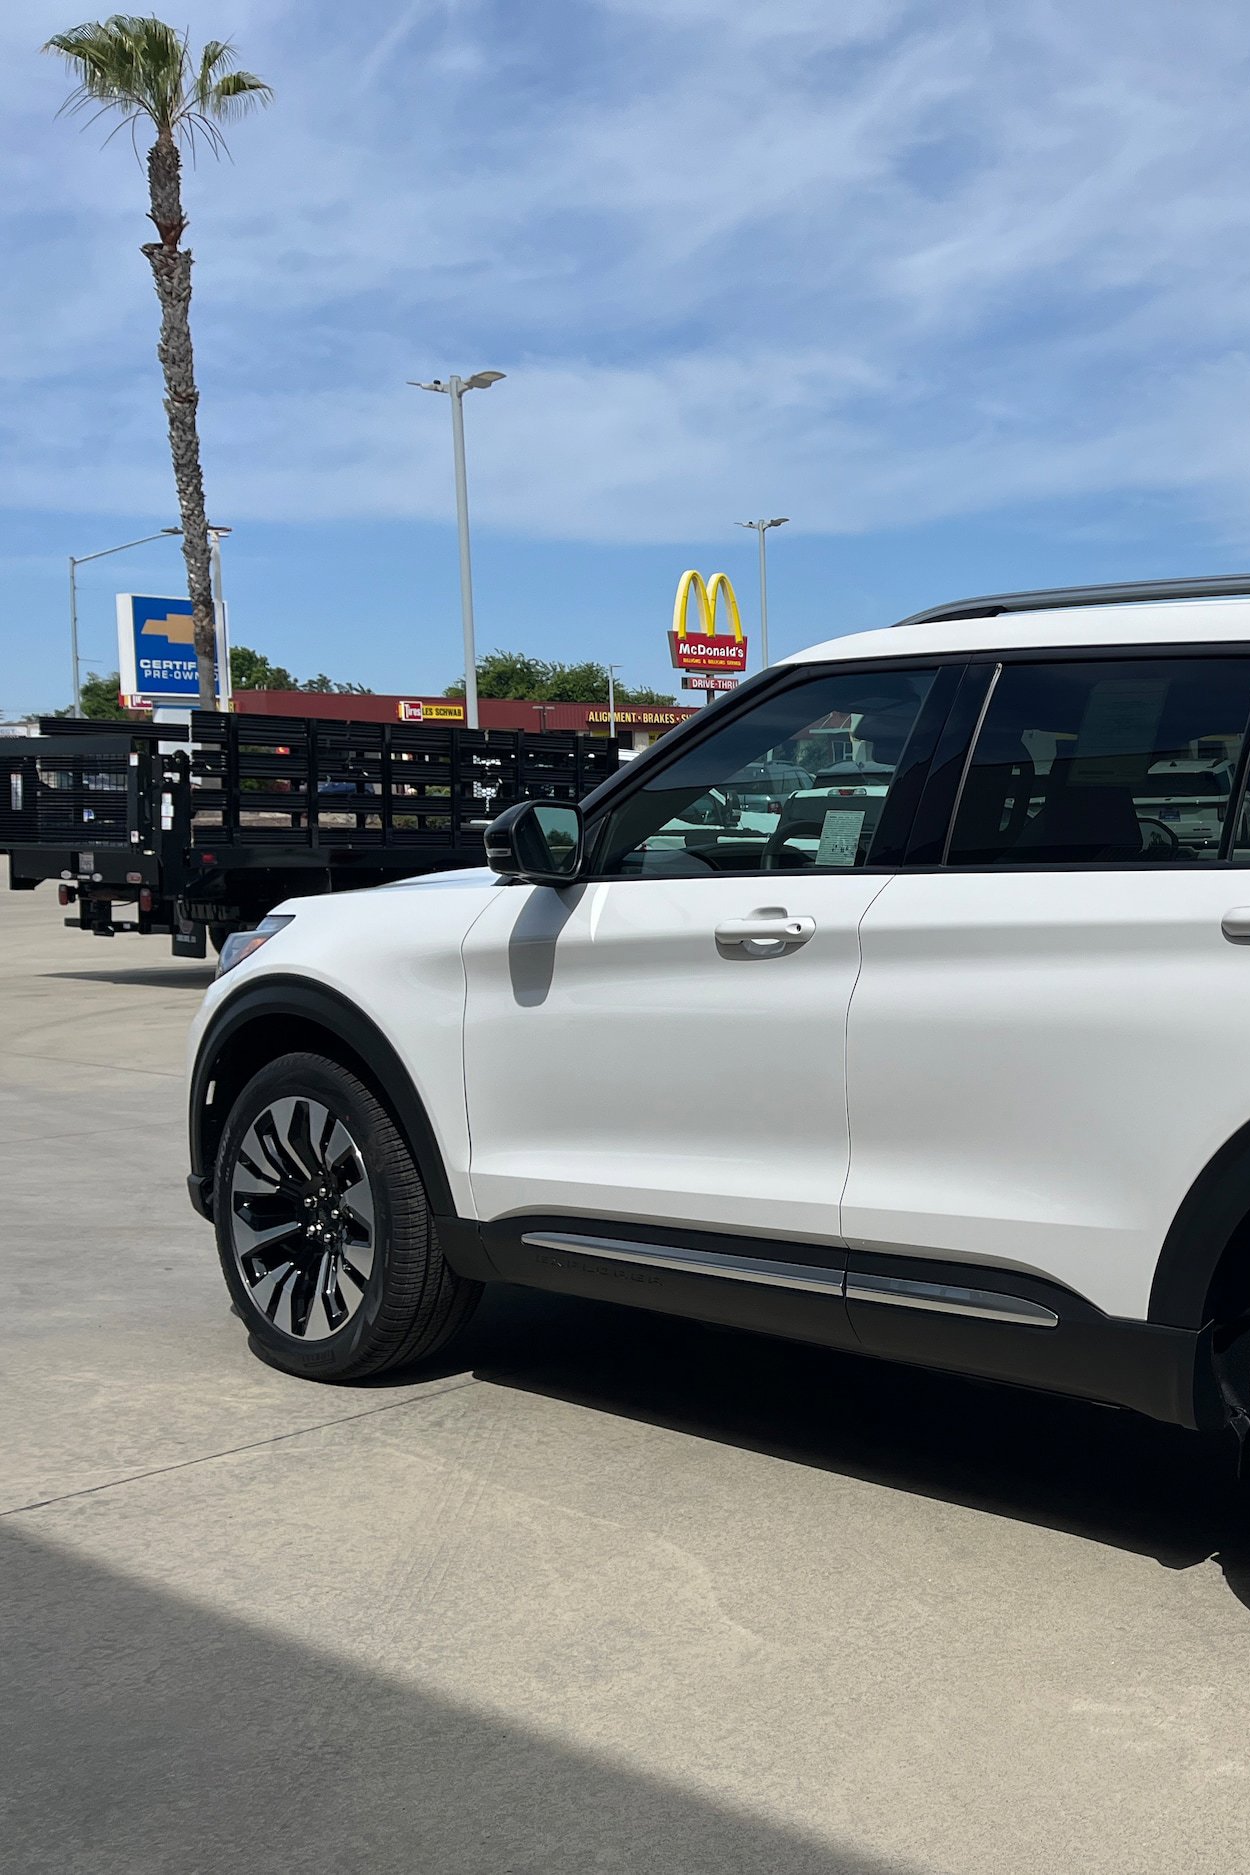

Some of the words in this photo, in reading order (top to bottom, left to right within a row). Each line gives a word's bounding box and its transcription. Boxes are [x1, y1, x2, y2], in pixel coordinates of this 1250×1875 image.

[678, 643, 744, 658] McDonald's
[421, 707, 433, 717] LES
[435, 707, 462, 718] SCHWAB
[642, 713, 675, 724] BRAKES
